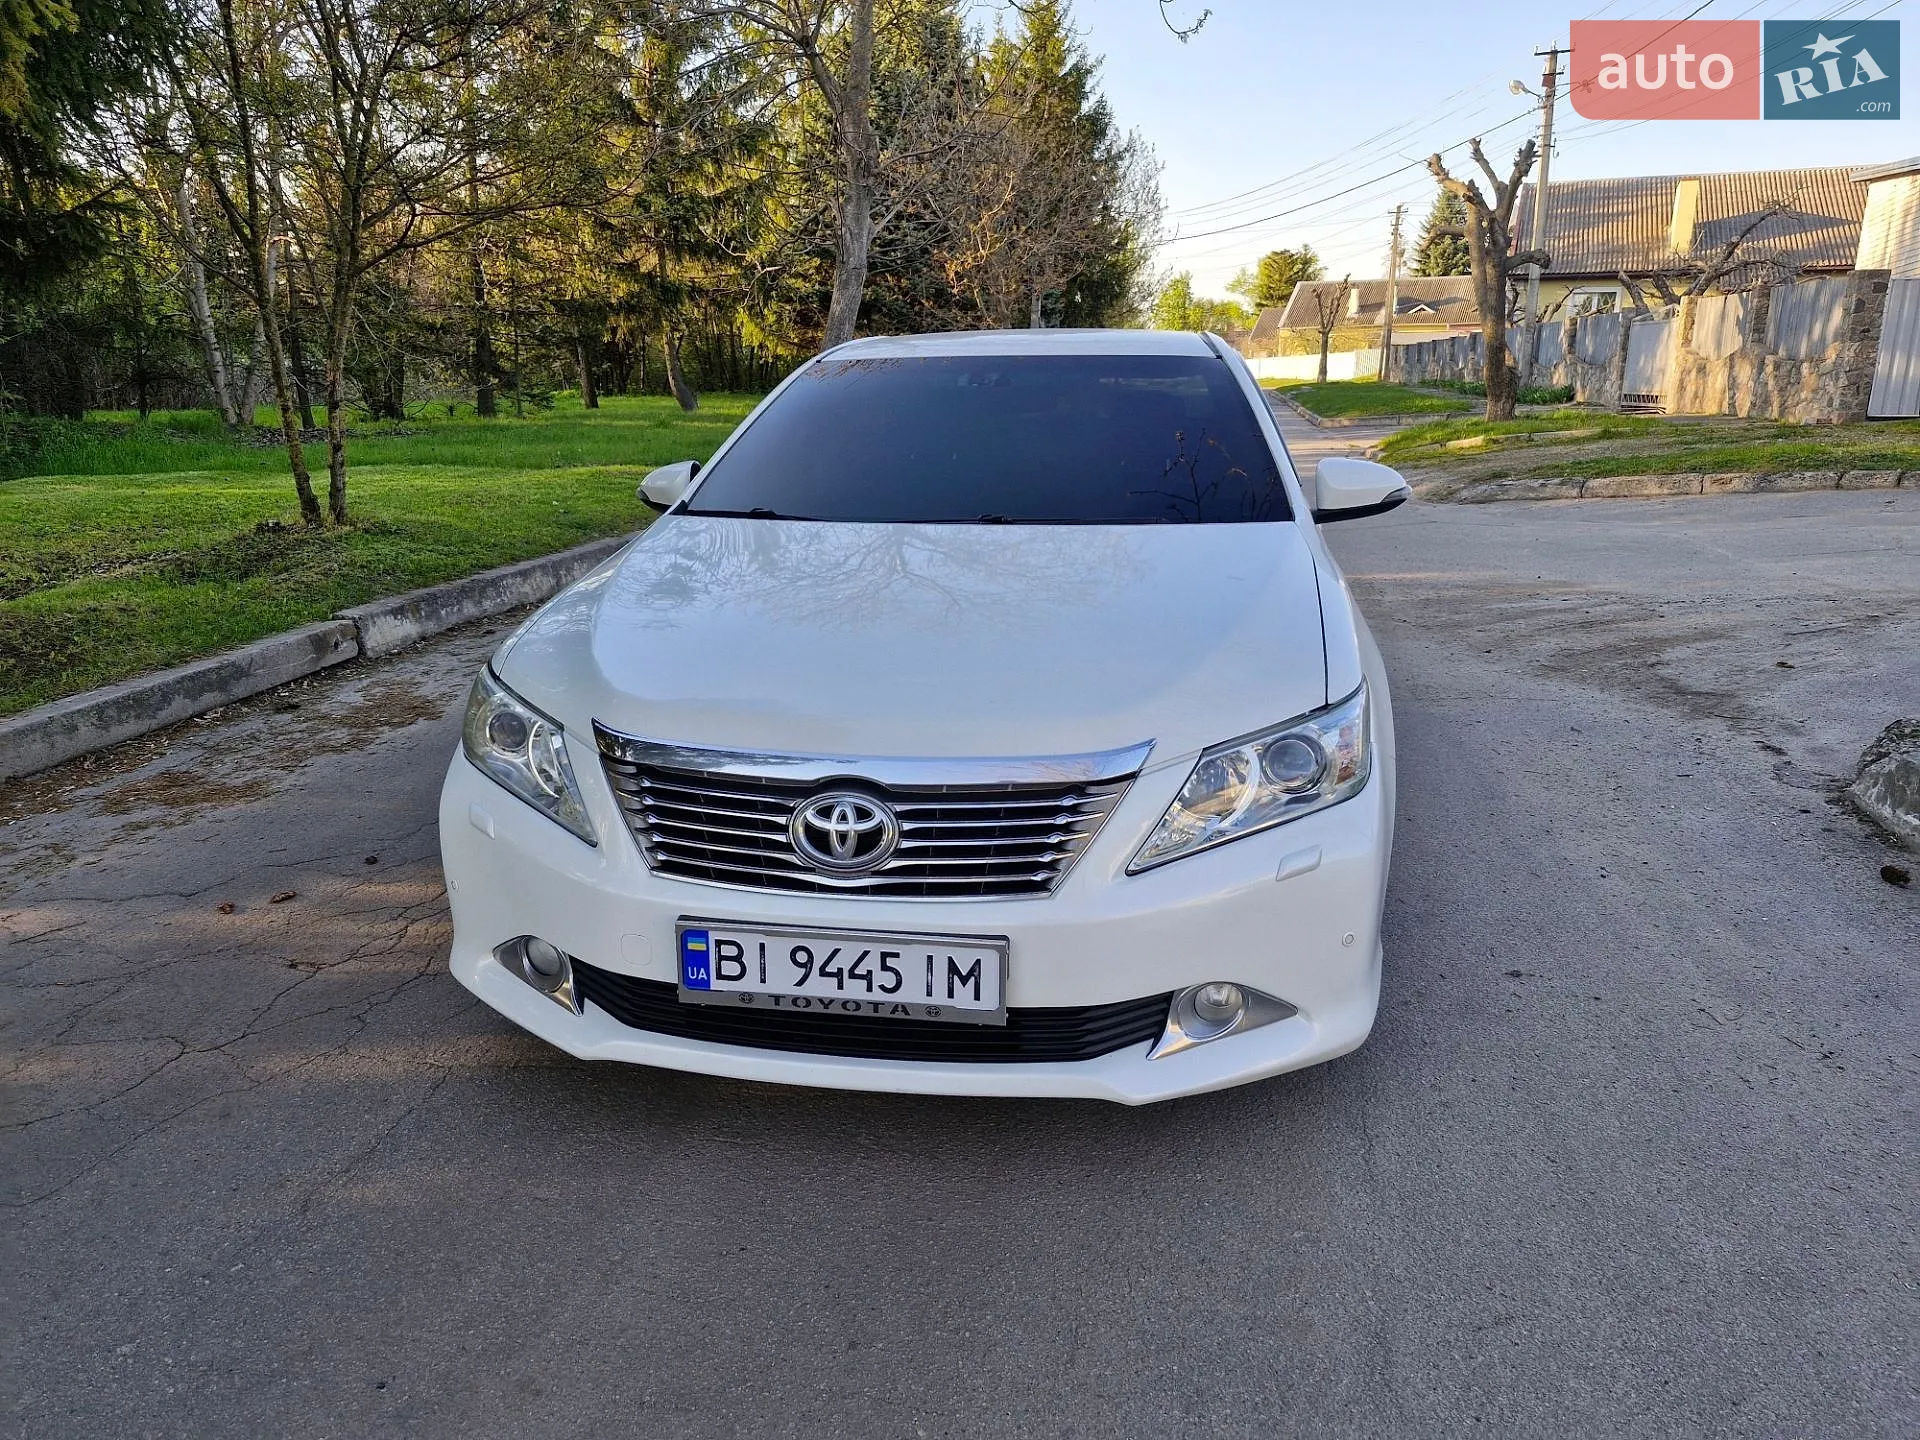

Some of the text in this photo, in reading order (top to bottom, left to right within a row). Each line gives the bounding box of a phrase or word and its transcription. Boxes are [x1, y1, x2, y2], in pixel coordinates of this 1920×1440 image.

[687, 966, 708, 981] UA
[714, 938, 982, 1001] BI 9445 IM
[767, 995, 911, 1016] TOYOTA
